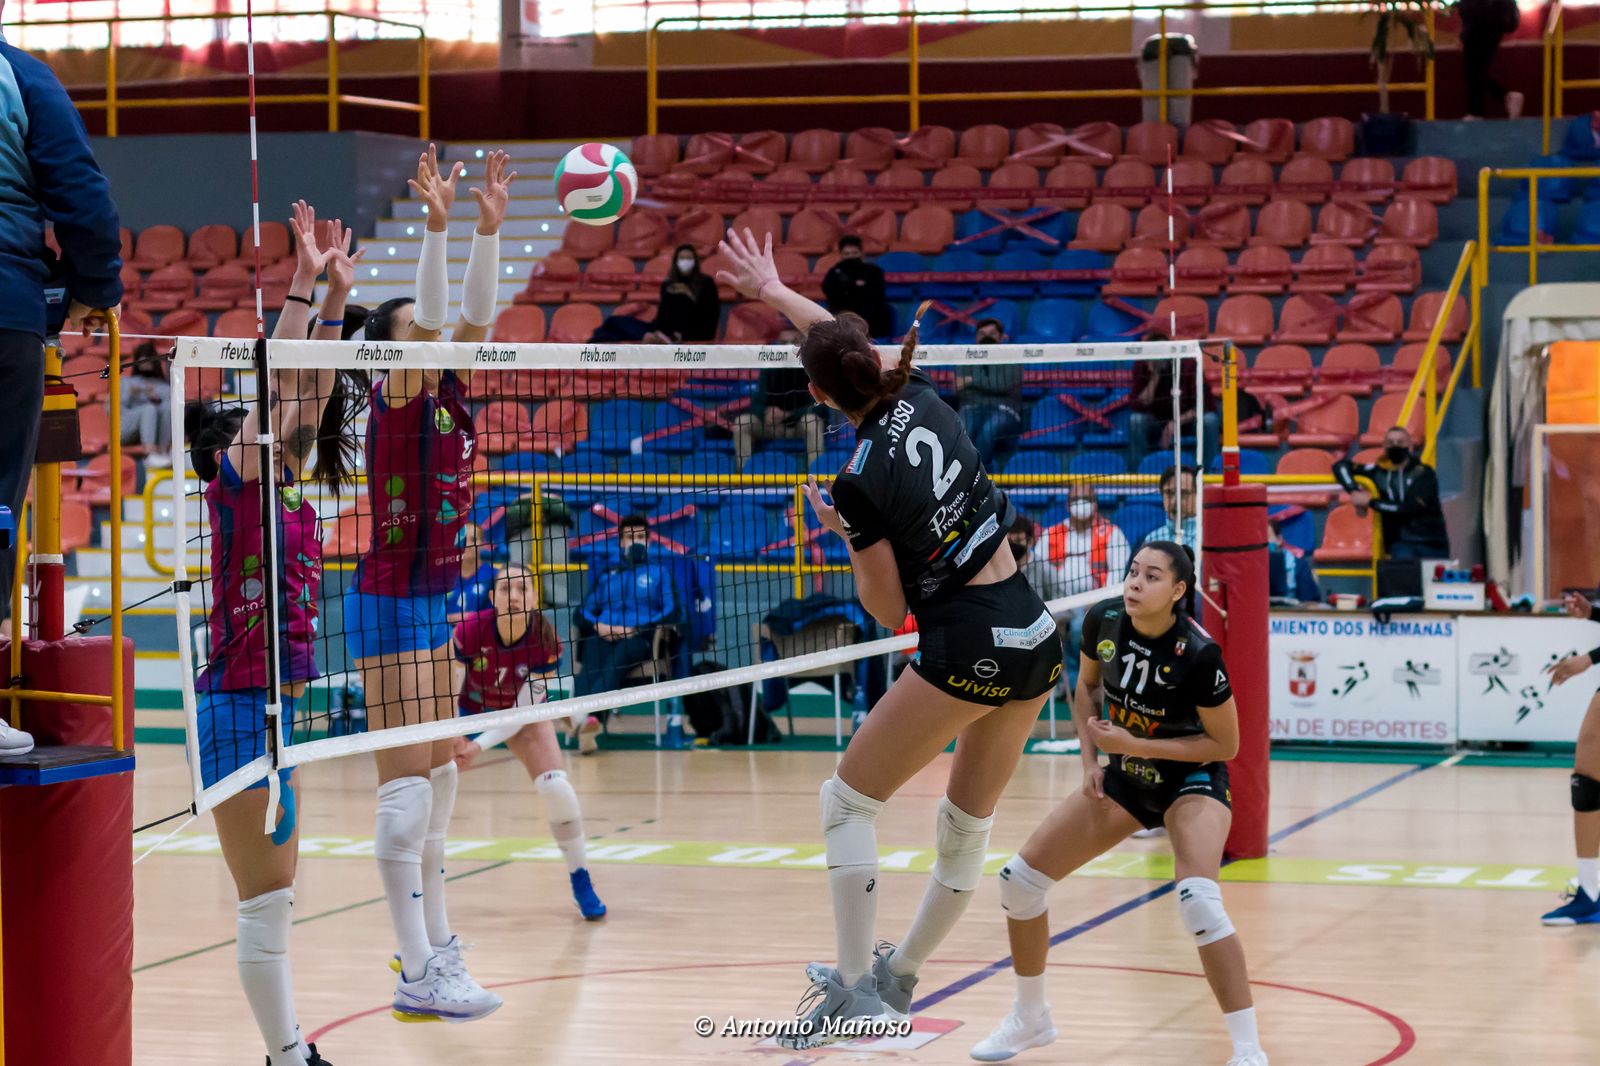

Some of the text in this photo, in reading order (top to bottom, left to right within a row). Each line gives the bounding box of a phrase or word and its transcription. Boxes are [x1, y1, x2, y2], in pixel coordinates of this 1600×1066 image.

[355, 344, 403, 361] rfevb.com
[475, 346, 516, 362] rfevb.com
[580, 347, 616, 363] rfevb.com
[905, 426, 962, 500] 2
[1333, 621, 1364, 636] DOS
[1369, 621, 1453, 637] HERMANAS
[1120, 652, 1149, 695] 11
[1296, 719, 1325, 736] DE
[1332, 720, 1448, 739] DEPORTES
